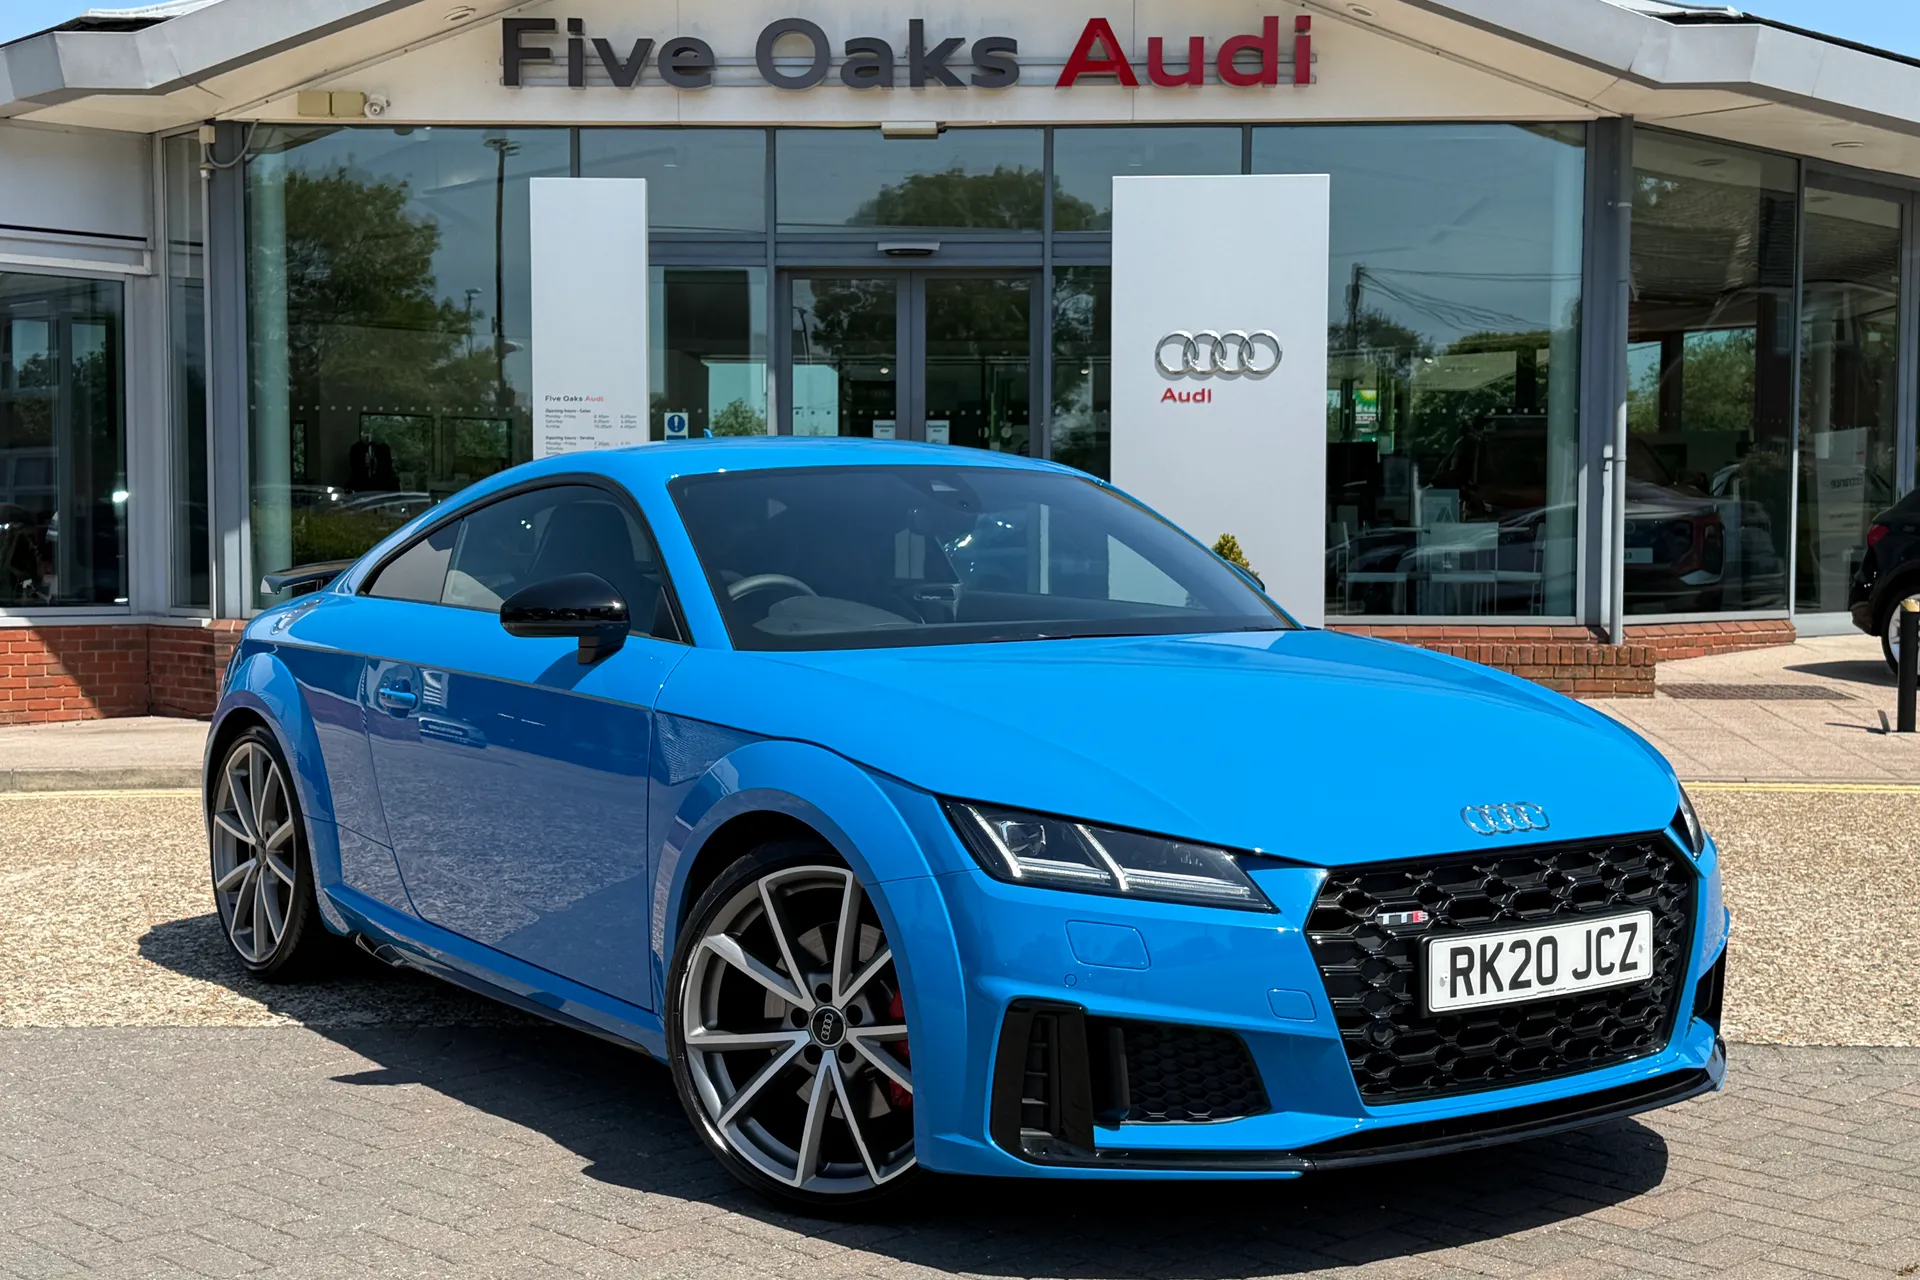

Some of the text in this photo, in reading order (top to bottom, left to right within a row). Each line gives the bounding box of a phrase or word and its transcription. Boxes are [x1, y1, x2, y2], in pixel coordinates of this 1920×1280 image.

[502, 15, 1314, 90] Five Oaks Audi
[1161, 387, 1212, 403] Audi
[1377, 909, 1429, 925] TTS
[1449, 921, 1639, 999] RK20 JCZ
